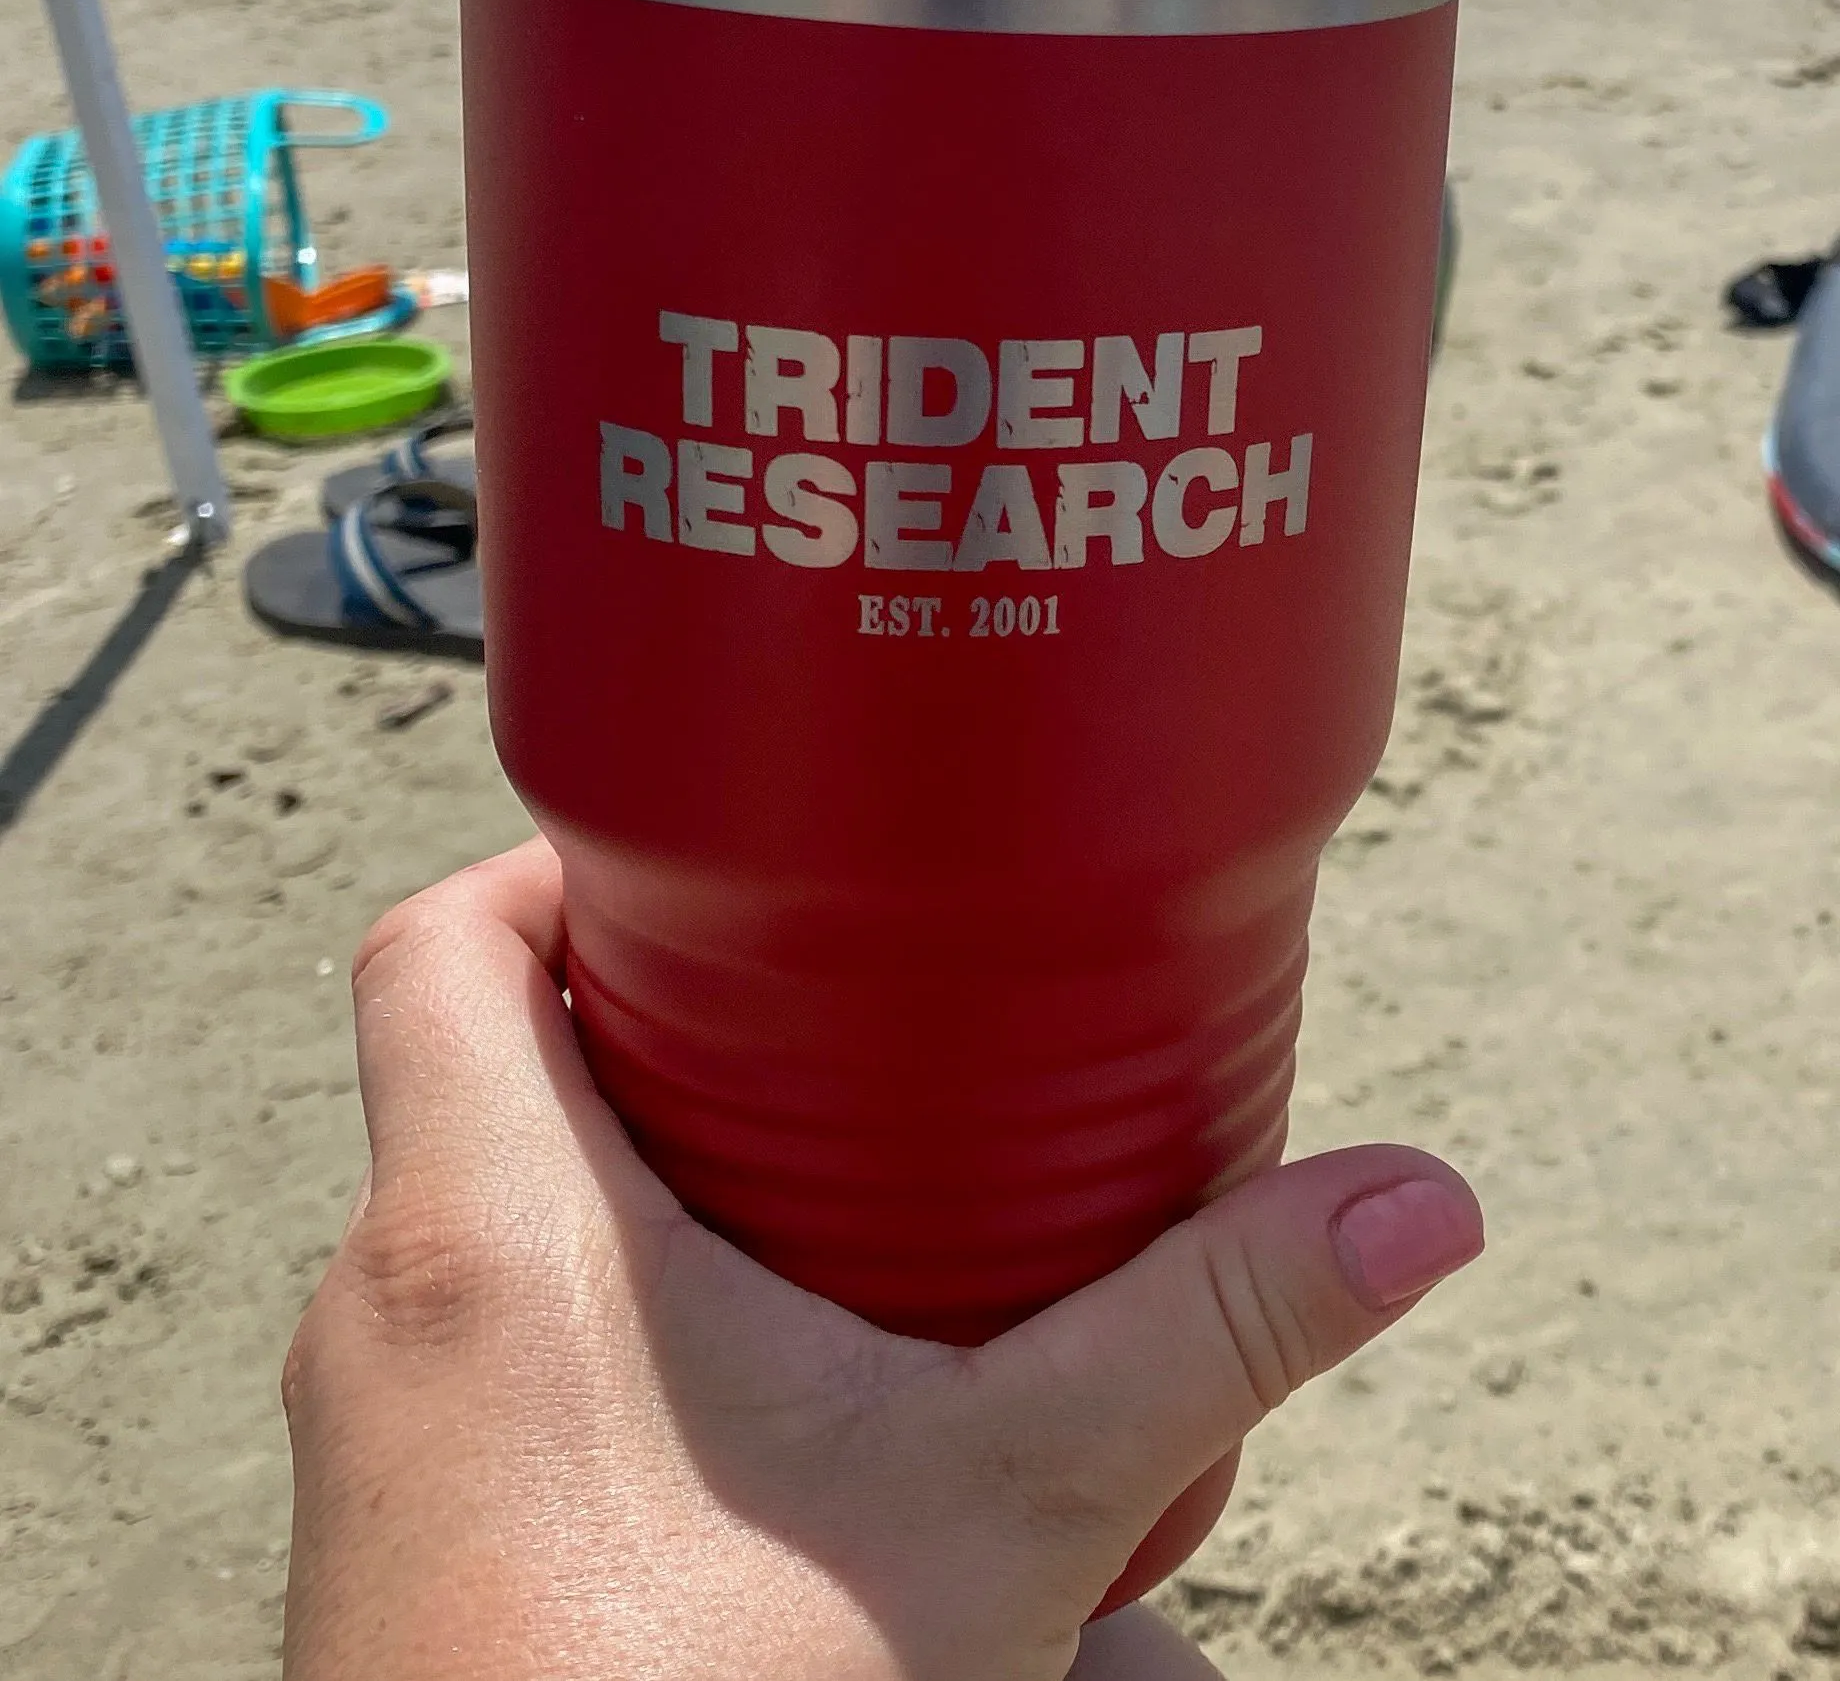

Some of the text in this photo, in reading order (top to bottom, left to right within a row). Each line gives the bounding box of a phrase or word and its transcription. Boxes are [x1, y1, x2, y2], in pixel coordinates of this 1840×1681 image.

[659, 309, 1263, 450] TRIDENT
[599, 420, 1314, 573] RESEARCH
[857, 594, 1061, 637] EST. 2001
